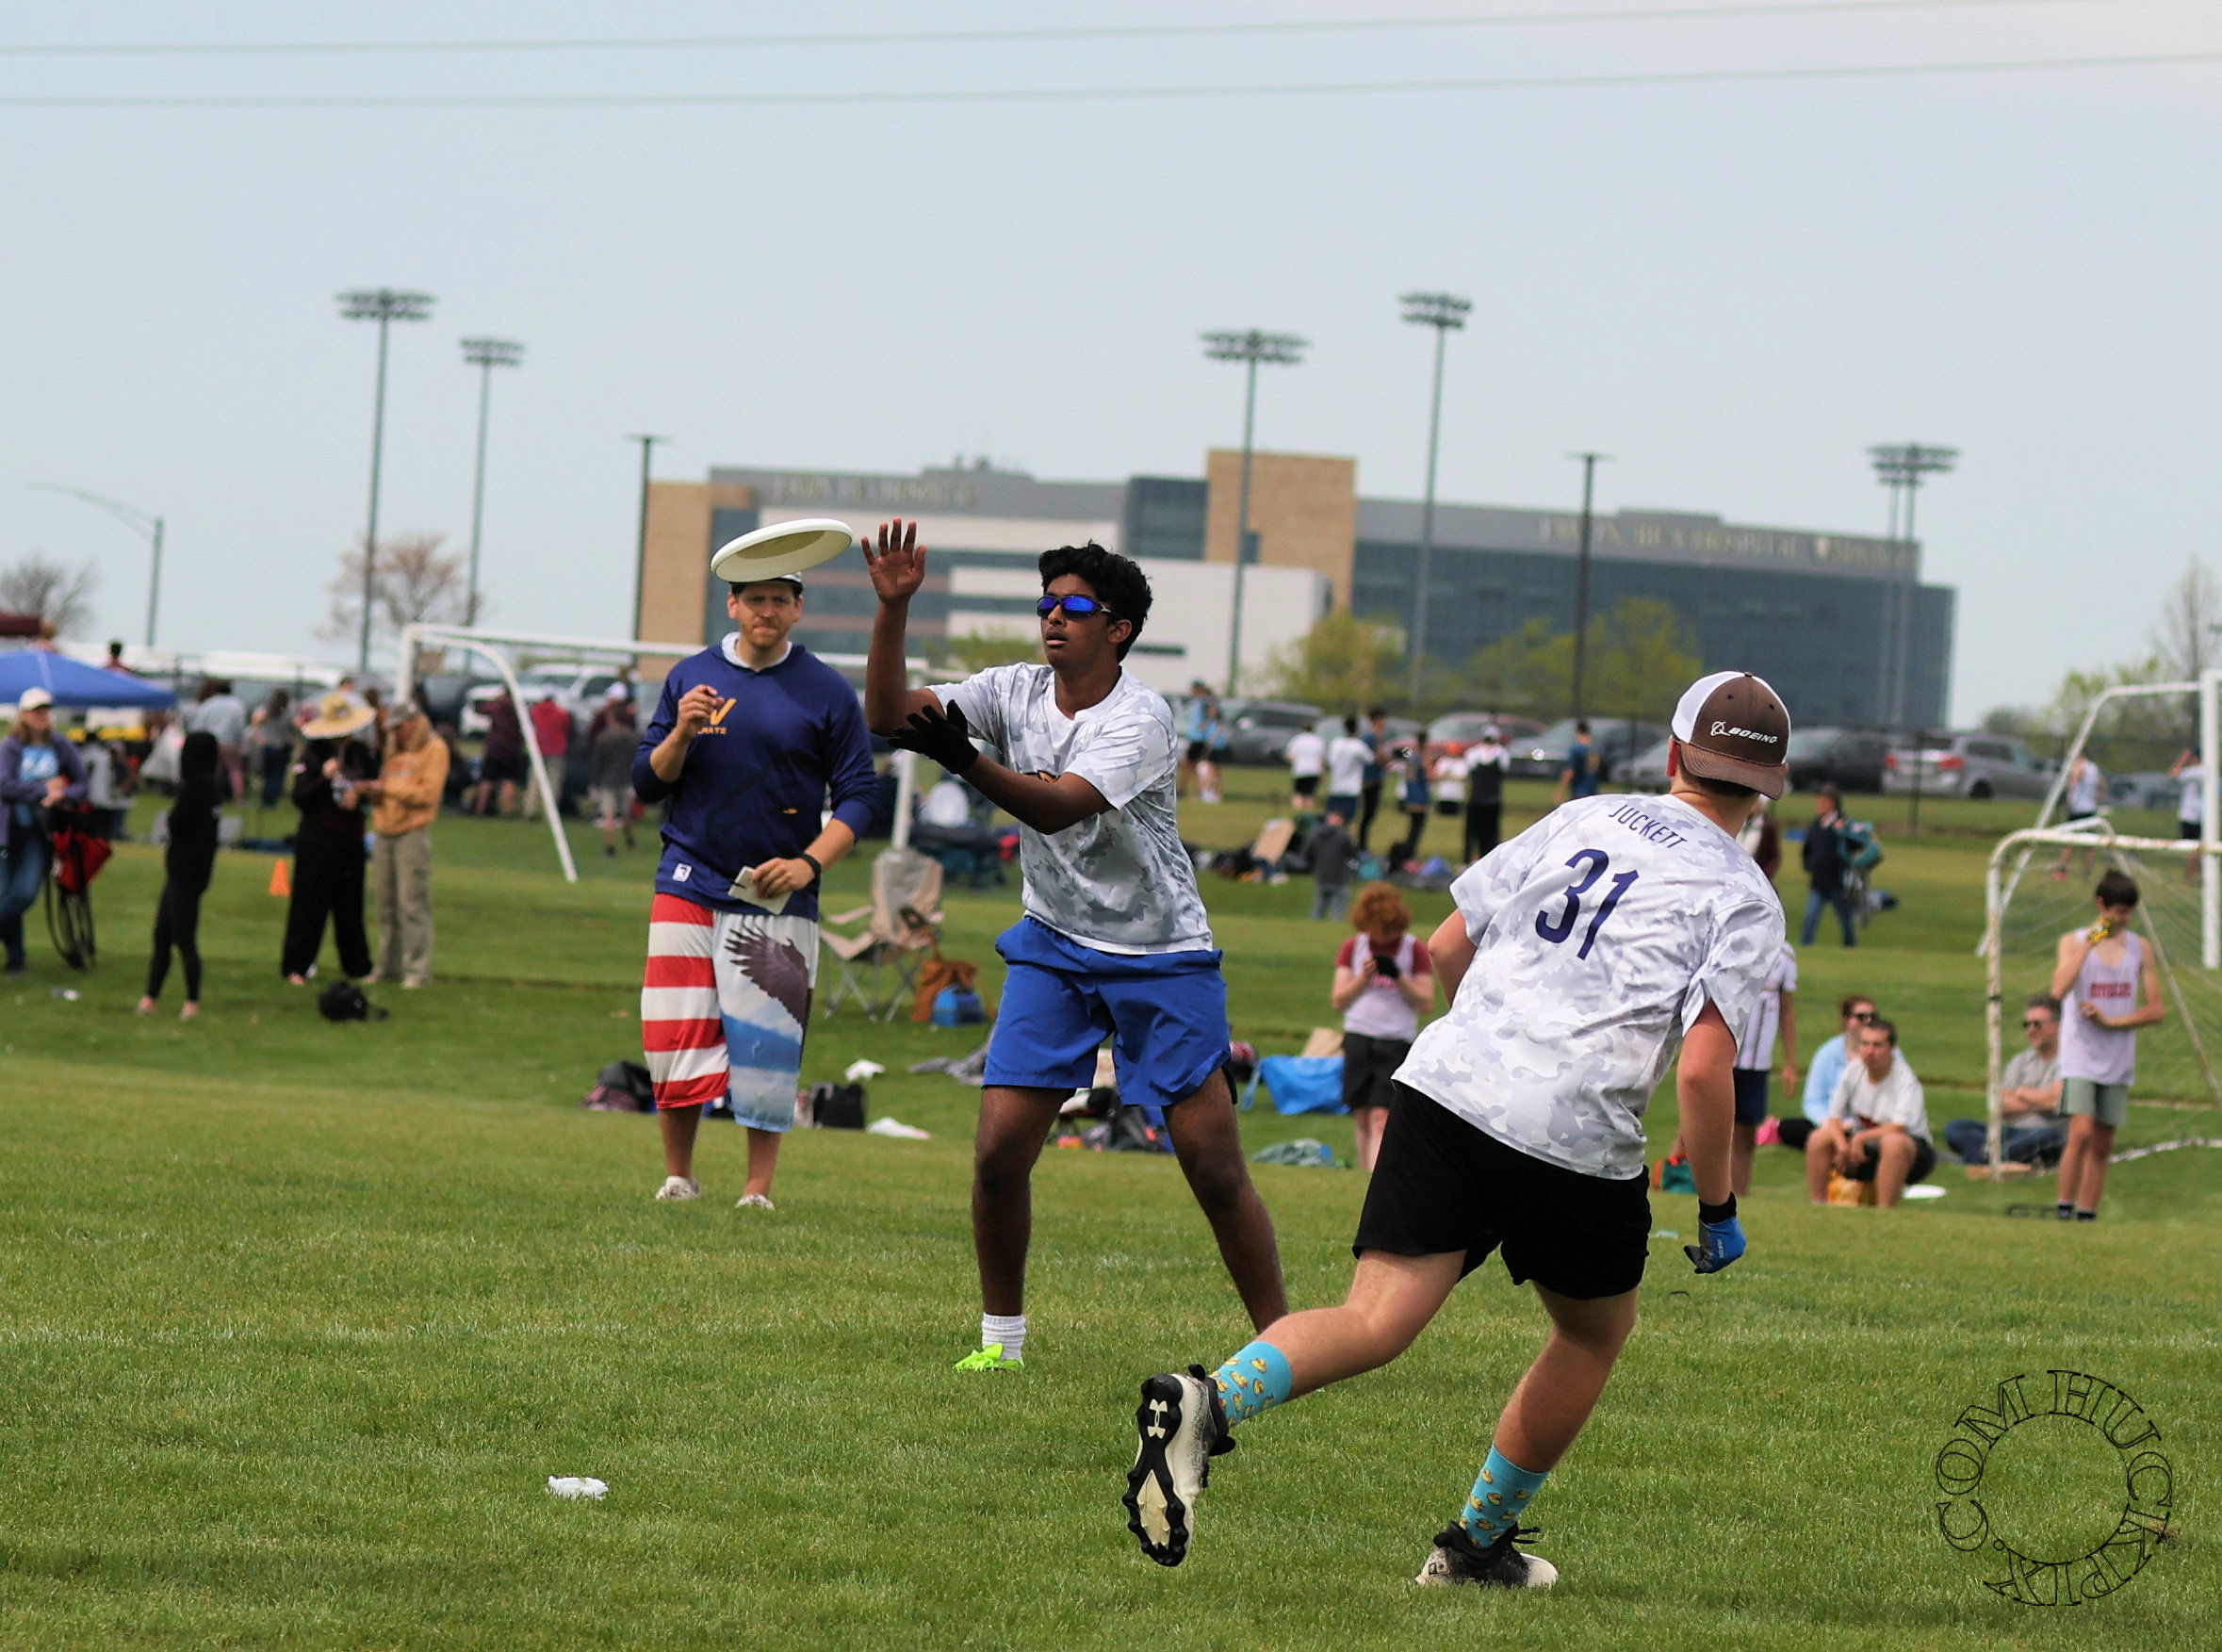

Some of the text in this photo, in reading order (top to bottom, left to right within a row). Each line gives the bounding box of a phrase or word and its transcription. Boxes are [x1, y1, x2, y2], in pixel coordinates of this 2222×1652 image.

[1728, 727, 1778, 744] BOEING
[1609, 804, 1688, 849] JUCKETT
[1535, 848, 1639, 960] 31
